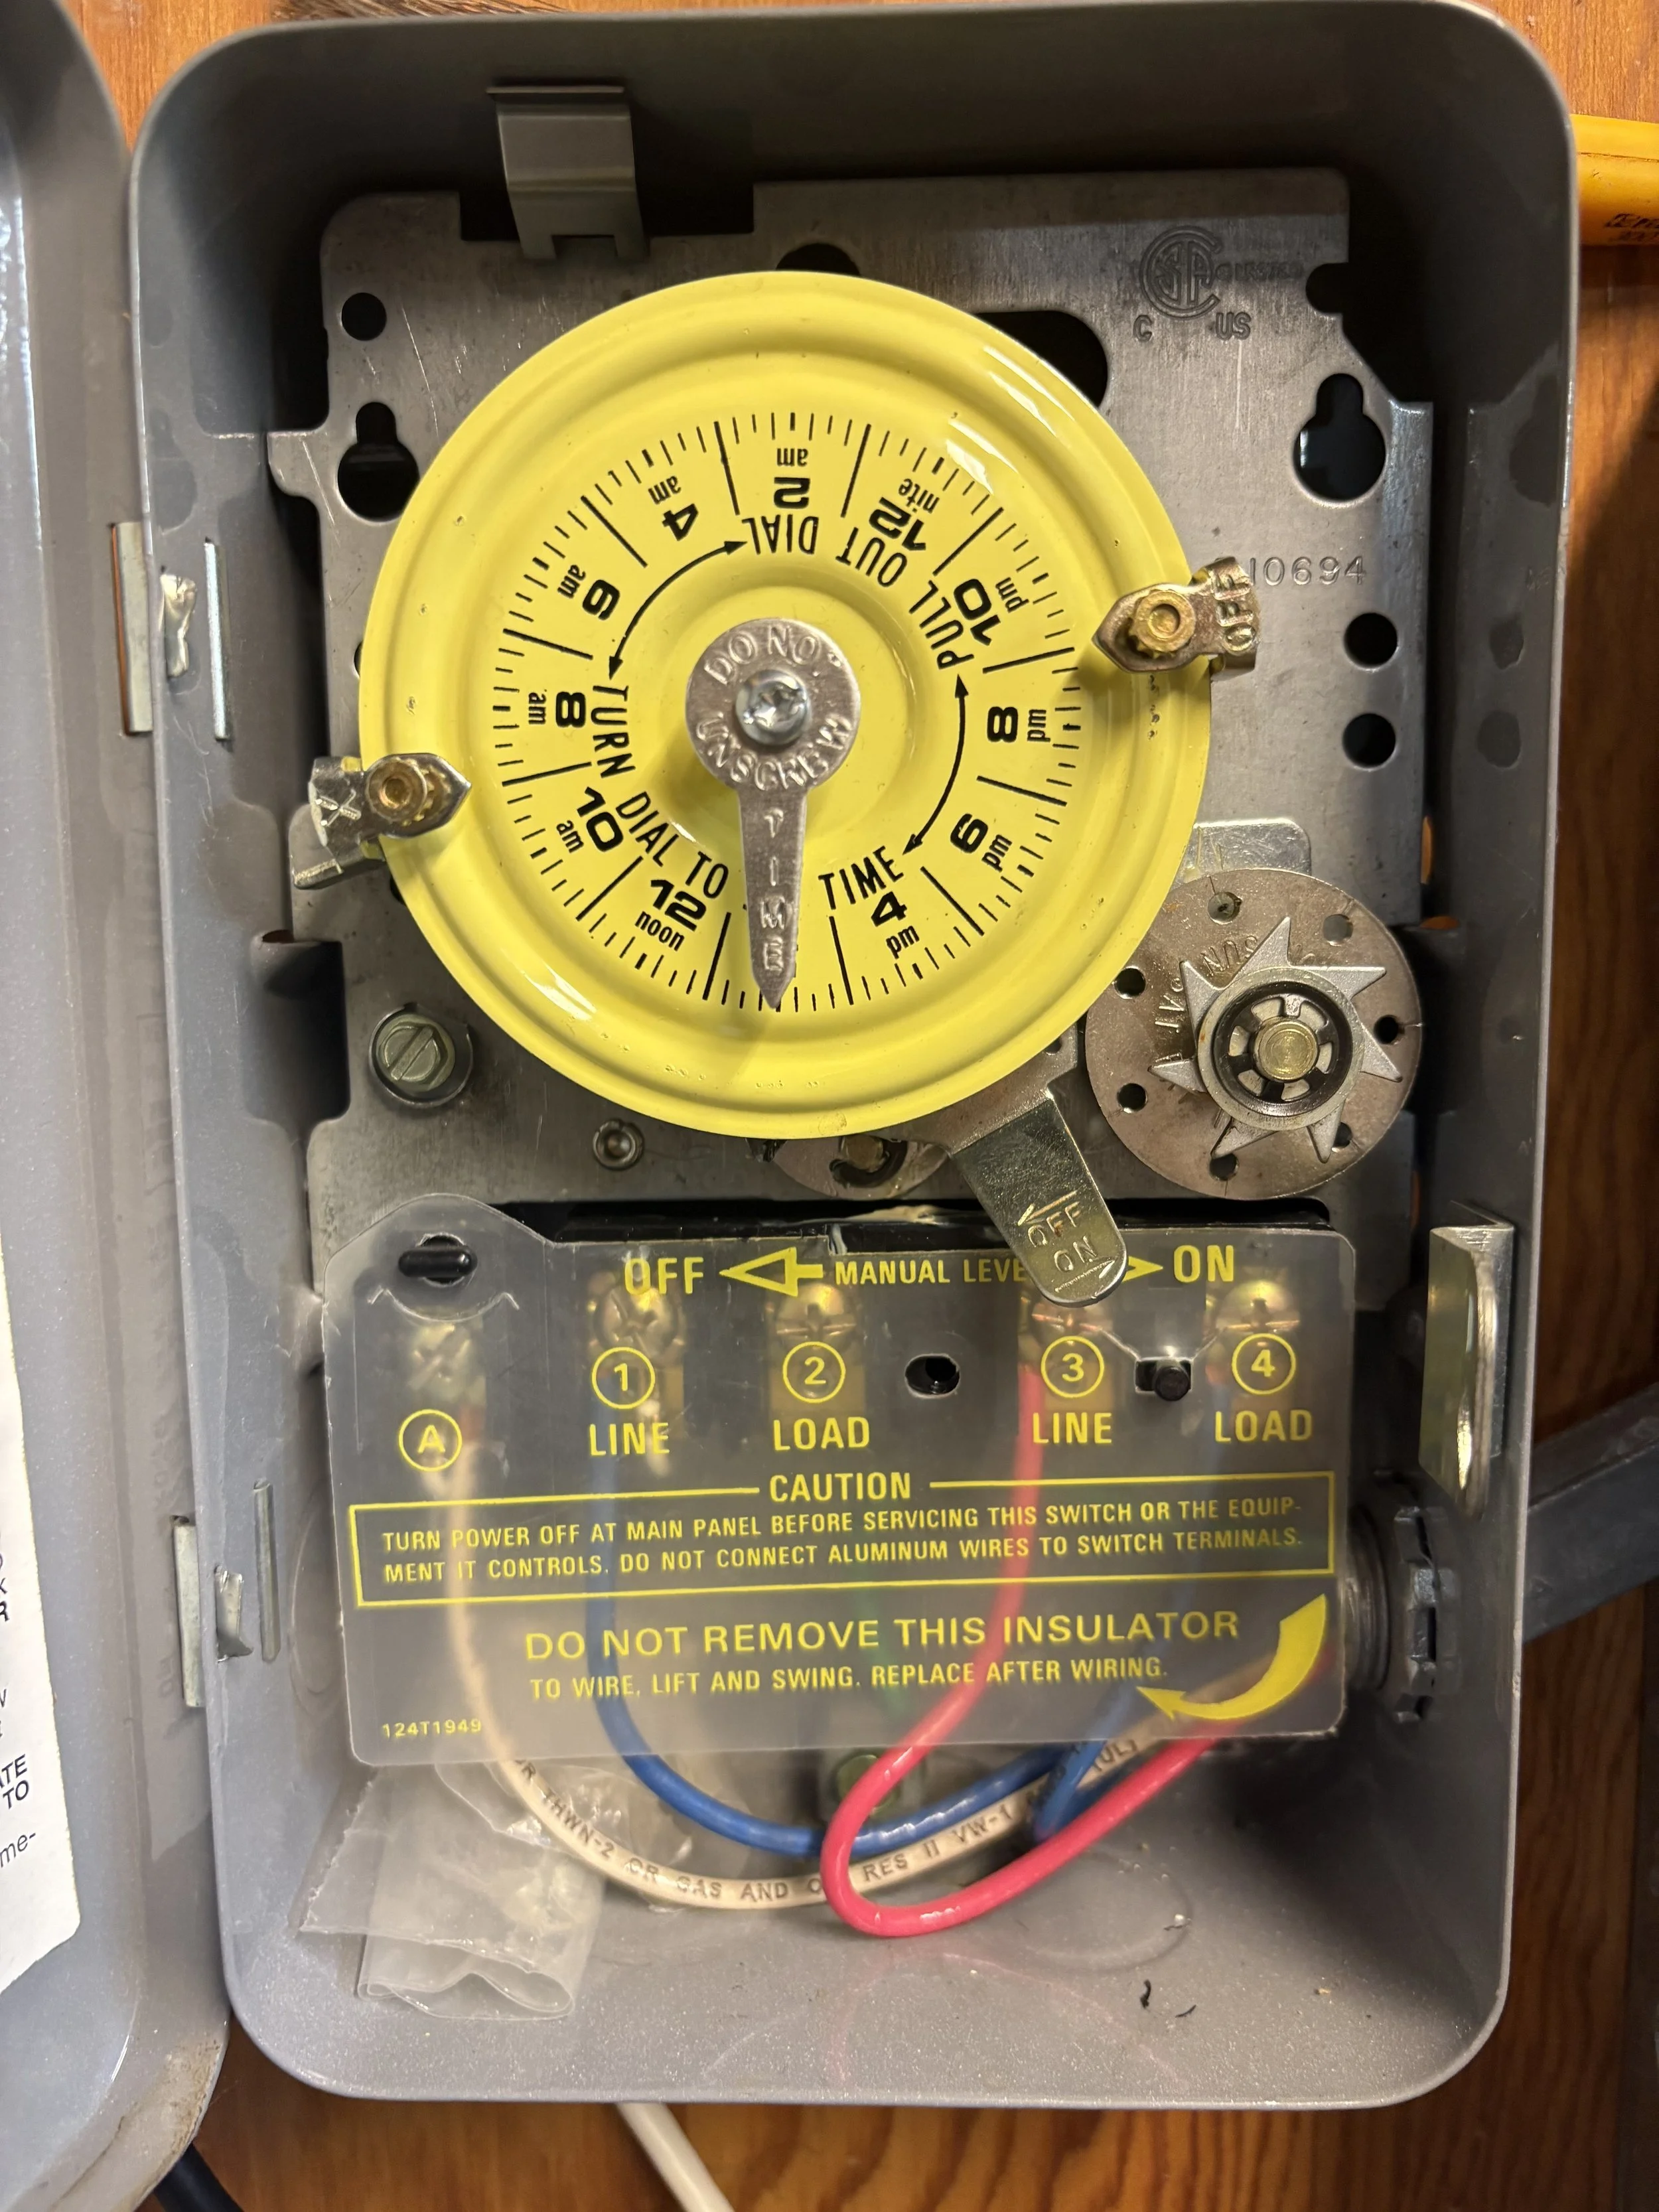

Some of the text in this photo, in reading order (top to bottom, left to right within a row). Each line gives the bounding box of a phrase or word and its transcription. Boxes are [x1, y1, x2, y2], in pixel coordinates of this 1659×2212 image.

[1215, 311, 1252, 340] US
[777, 449, 808, 467] am
[648, 476, 681, 504] am
[774, 477, 810, 509] 2
[898, 478, 940, 514] nite
[662, 503, 699, 542] 4
[869, 496, 926, 551] 12
[557, 565, 586, 599] am
[741, 514, 974, 670] PULL OUT DIAL
[995, 577, 1029, 613] pm
[582, 579, 620, 621] 6
[954, 578, 1001, 646] 10
[704, 632, 758, 685] DO
[528, 692, 547, 725] am
[555, 692, 586, 727] 8
[987, 706, 1019, 743] 8
[1027, 709, 1051, 742] pm
[590, 685, 904, 909] TURN DIAL TO TIME
[577, 786, 623, 851] 10
[950, 813, 988, 853] 6
[556, 820, 585, 853] am
[981, 834, 1013, 872] pm
[650, 879, 707, 931] 12
[871, 891, 908, 926] 4
[635, 911, 685, 952] noon
[886, 925, 920, 959] pm
[1027, 1201, 1082, 1247] OFF
[624, 1245, 1234, 1295] OFF MANUAL LEVE ON
[1054, 1236, 1096, 1272] ON
[614, 1363, 628, 1392] 1
[804, 1357, 827, 1386] 2
[1062, 1353, 1084, 1382] 3
[1252, 1349, 1275, 1377] 4
[418, 1425, 445, 1453] A
[589, 1423, 670, 1456] LINE
[774, 1417, 870, 1451] LOAD
[1033, 1412, 1112, 1444] LINE
[1215, 1410, 1313, 1442] LOAD
[770, 1473, 910, 1503] CAUTION
[383, 1497, 1301, 1551] TURN POWER OFF AT MAIN PANEL BEFORE SERVICING THIS SWITCH OR THE EQUIP-
[386, 1562, 445, 1583] MENT
[457, 1561, 476, 1580] IT
[620, 1553, 649, 1573] DO
[662, 1550, 705, 1570] NOT
[717, 1546, 818, 1568] CONNECT
[828, 1540, 948, 1563] ALUMINUM
[960, 1538, 1029, 1559] WIRES
[1039, 1536, 1067, 1556] TO
[1078, 1533, 1163, 1555] SWITCH
[1173, 1527, 1303, 1550] TERMINALS.
[526, 1611, 1237, 1660] DO NOT REMOVE THIS INSULATOR
[531, 1657, 1167, 1700] TO WIRE, LIFT AND SWING. REPLACE AFTER WIRING.
[382, 1719, 482, 1738] 124T1949
[0, 1754, 28, 1789] TE
[3, 1780, 29, 1809] TO
[624, 1858, 659, 1883] OR
[741, 1882, 788, 1902] AND
[863, 1853, 908, 1882] RES
[952, 1804, 1013, 1843] VW-1
